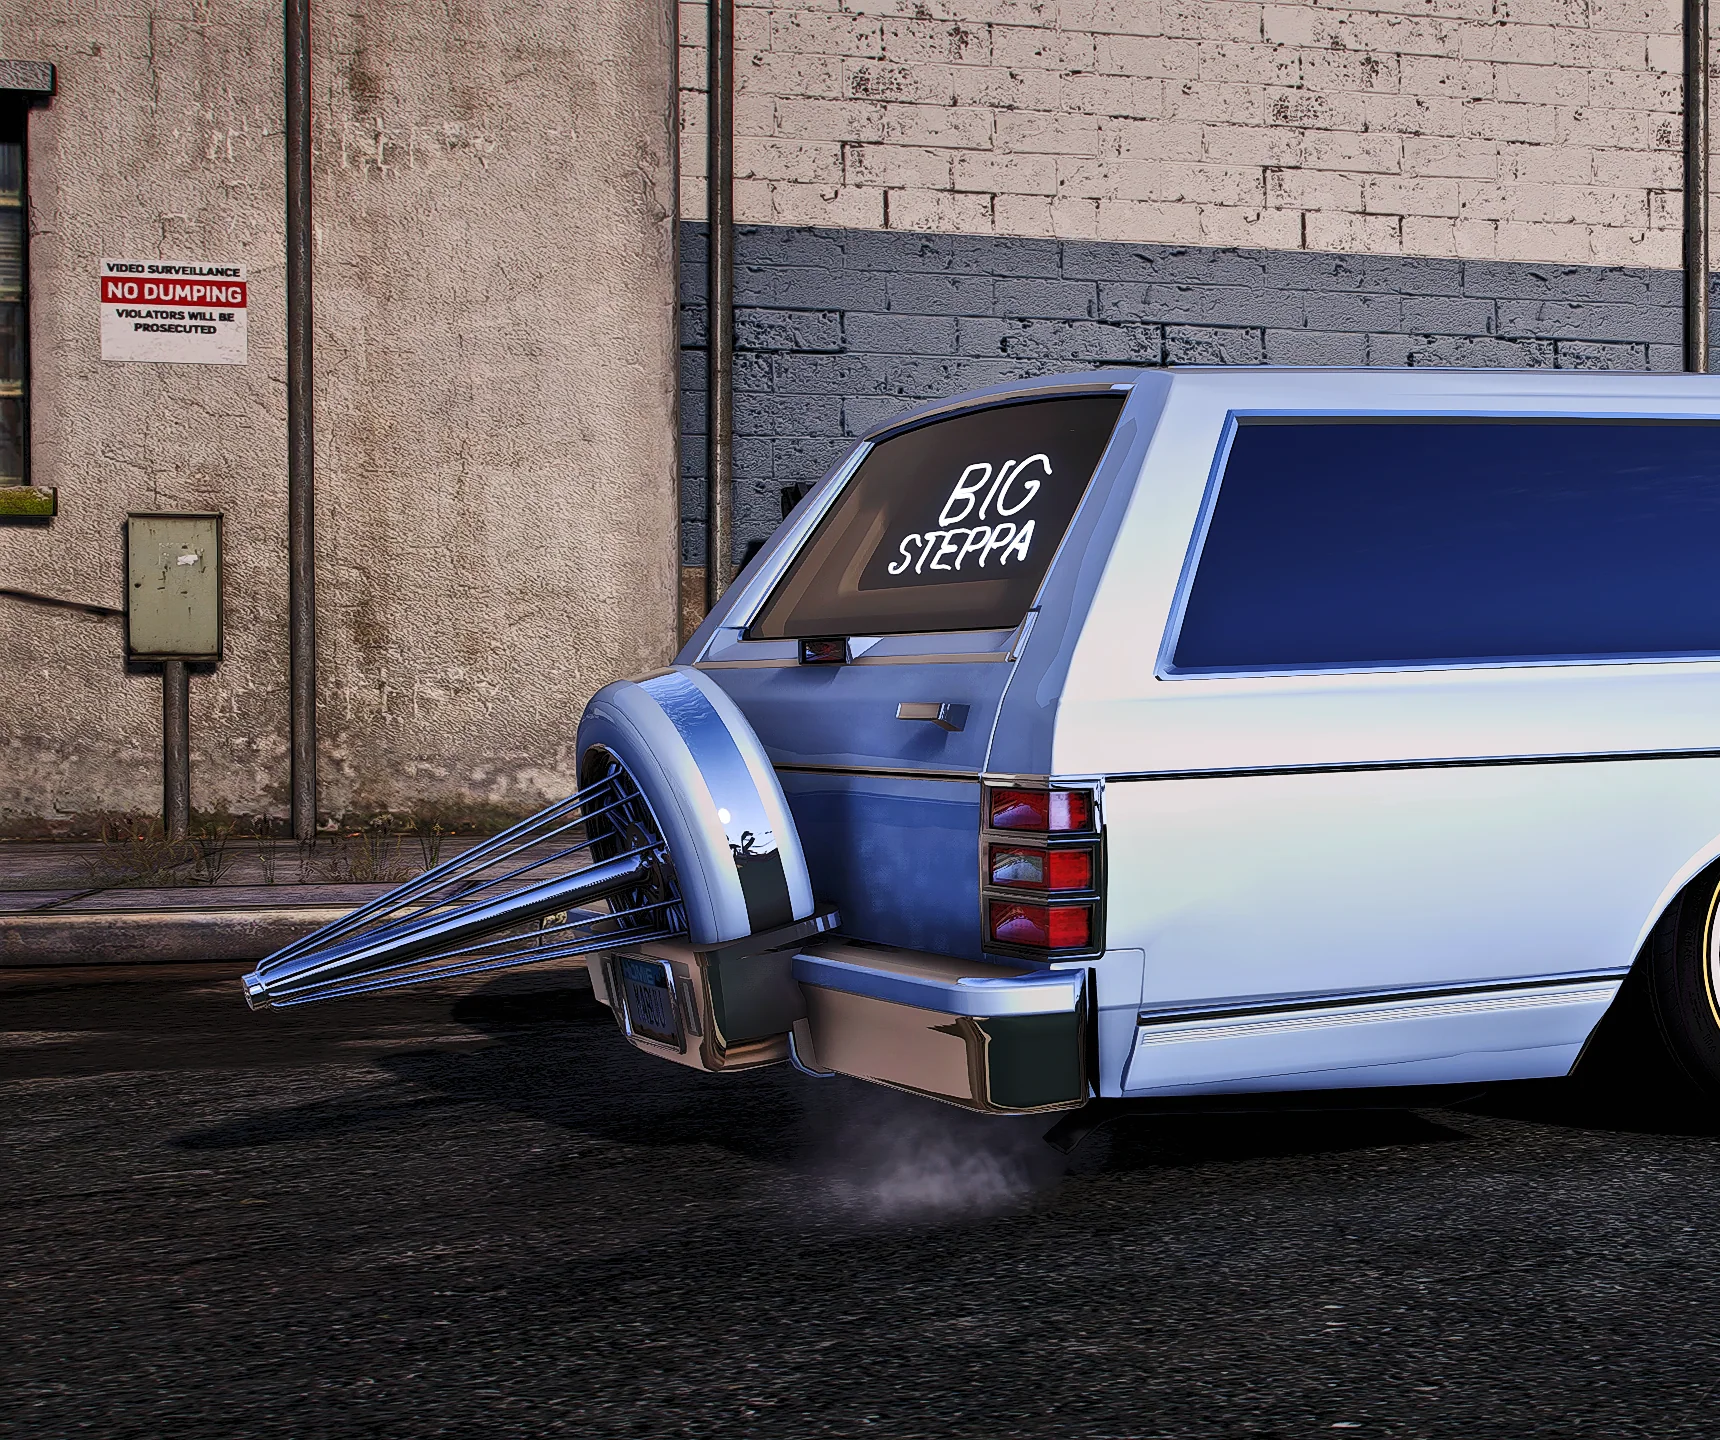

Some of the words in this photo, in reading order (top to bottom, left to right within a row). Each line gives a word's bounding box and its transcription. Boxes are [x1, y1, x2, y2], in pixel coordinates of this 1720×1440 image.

[106, 263, 145, 274] VIDEO
[147, 264, 241, 278] SURVEILLANCE
[107, 281, 139, 299] NO
[143, 283, 242, 303] DUMPING
[115, 308, 186, 320] VIOLATORS
[187, 311, 216, 321] WILL
[218, 312, 235, 322] BE
[133, 322, 217, 335] PROSECUTED
[938, 453, 1053, 527] BIG
[887, 519, 1036, 575] STEPPA
